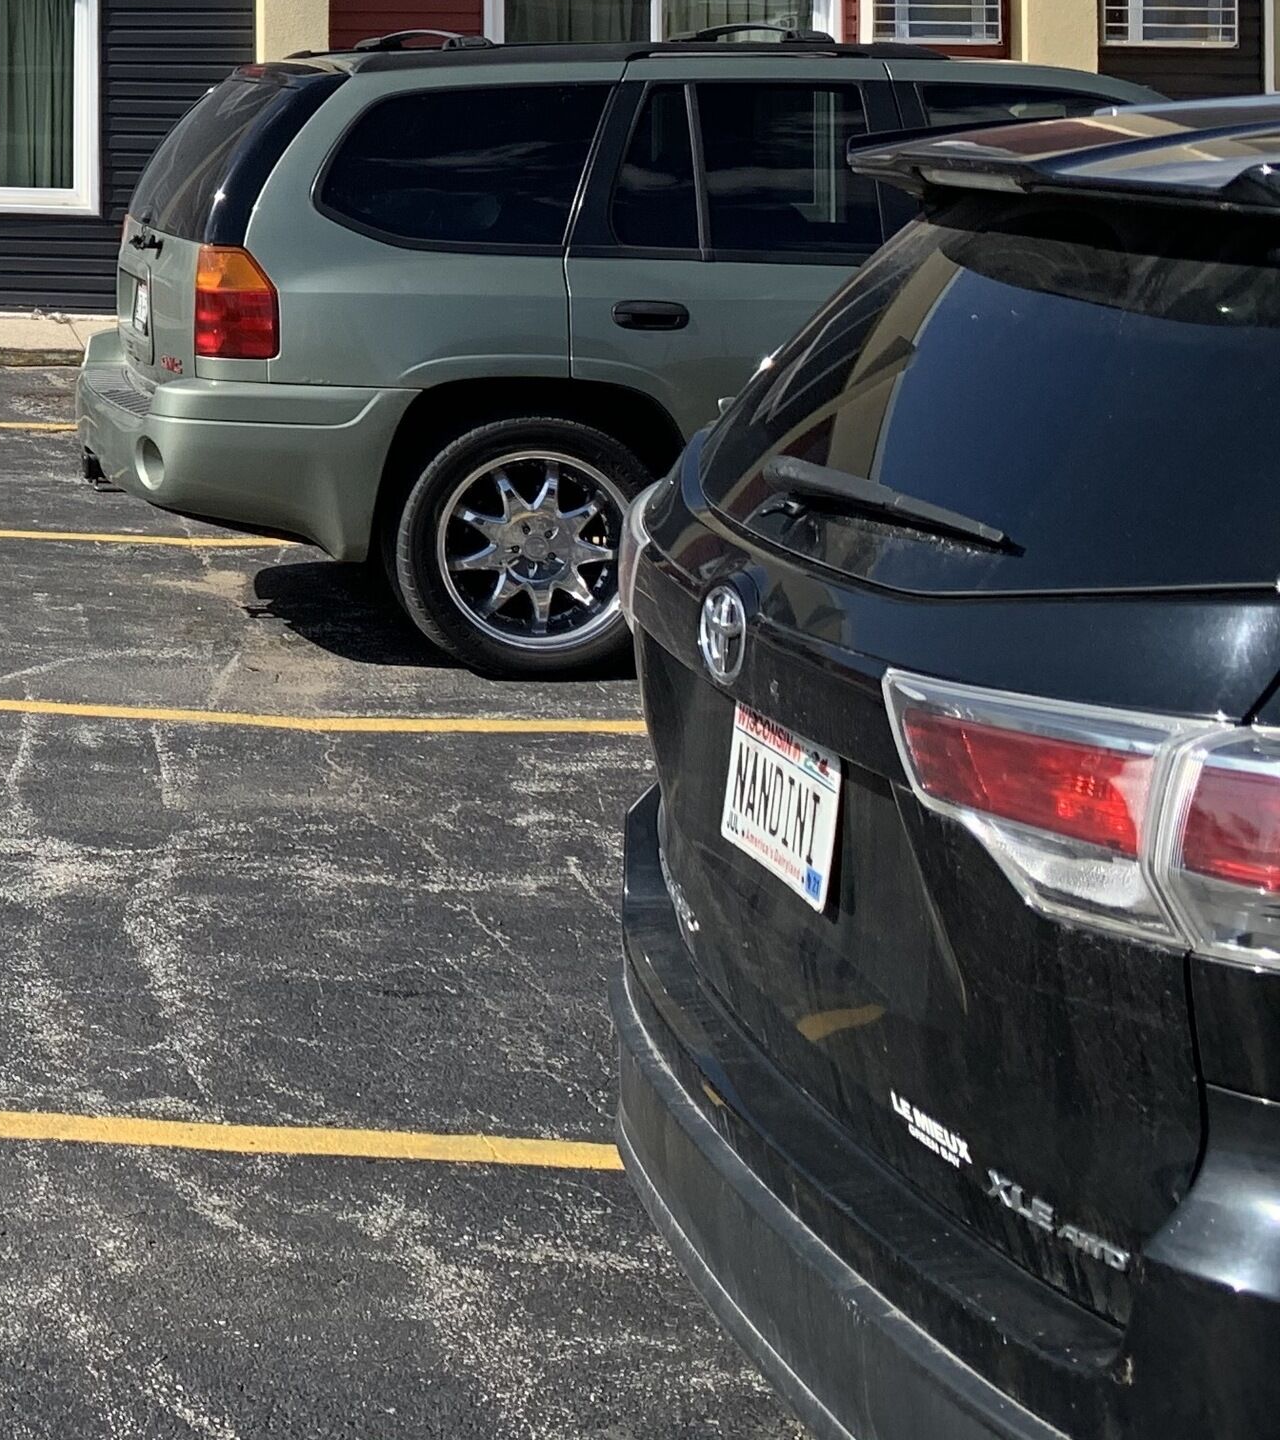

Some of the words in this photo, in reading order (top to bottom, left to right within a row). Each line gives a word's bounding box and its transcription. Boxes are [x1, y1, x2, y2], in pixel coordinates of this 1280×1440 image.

[737, 703, 794, 756] WISCONSIN
[733, 741, 820, 866] NANDINI
[913, 1107, 973, 1164] MIEUX
[987, 1169, 1054, 1232] XLE
